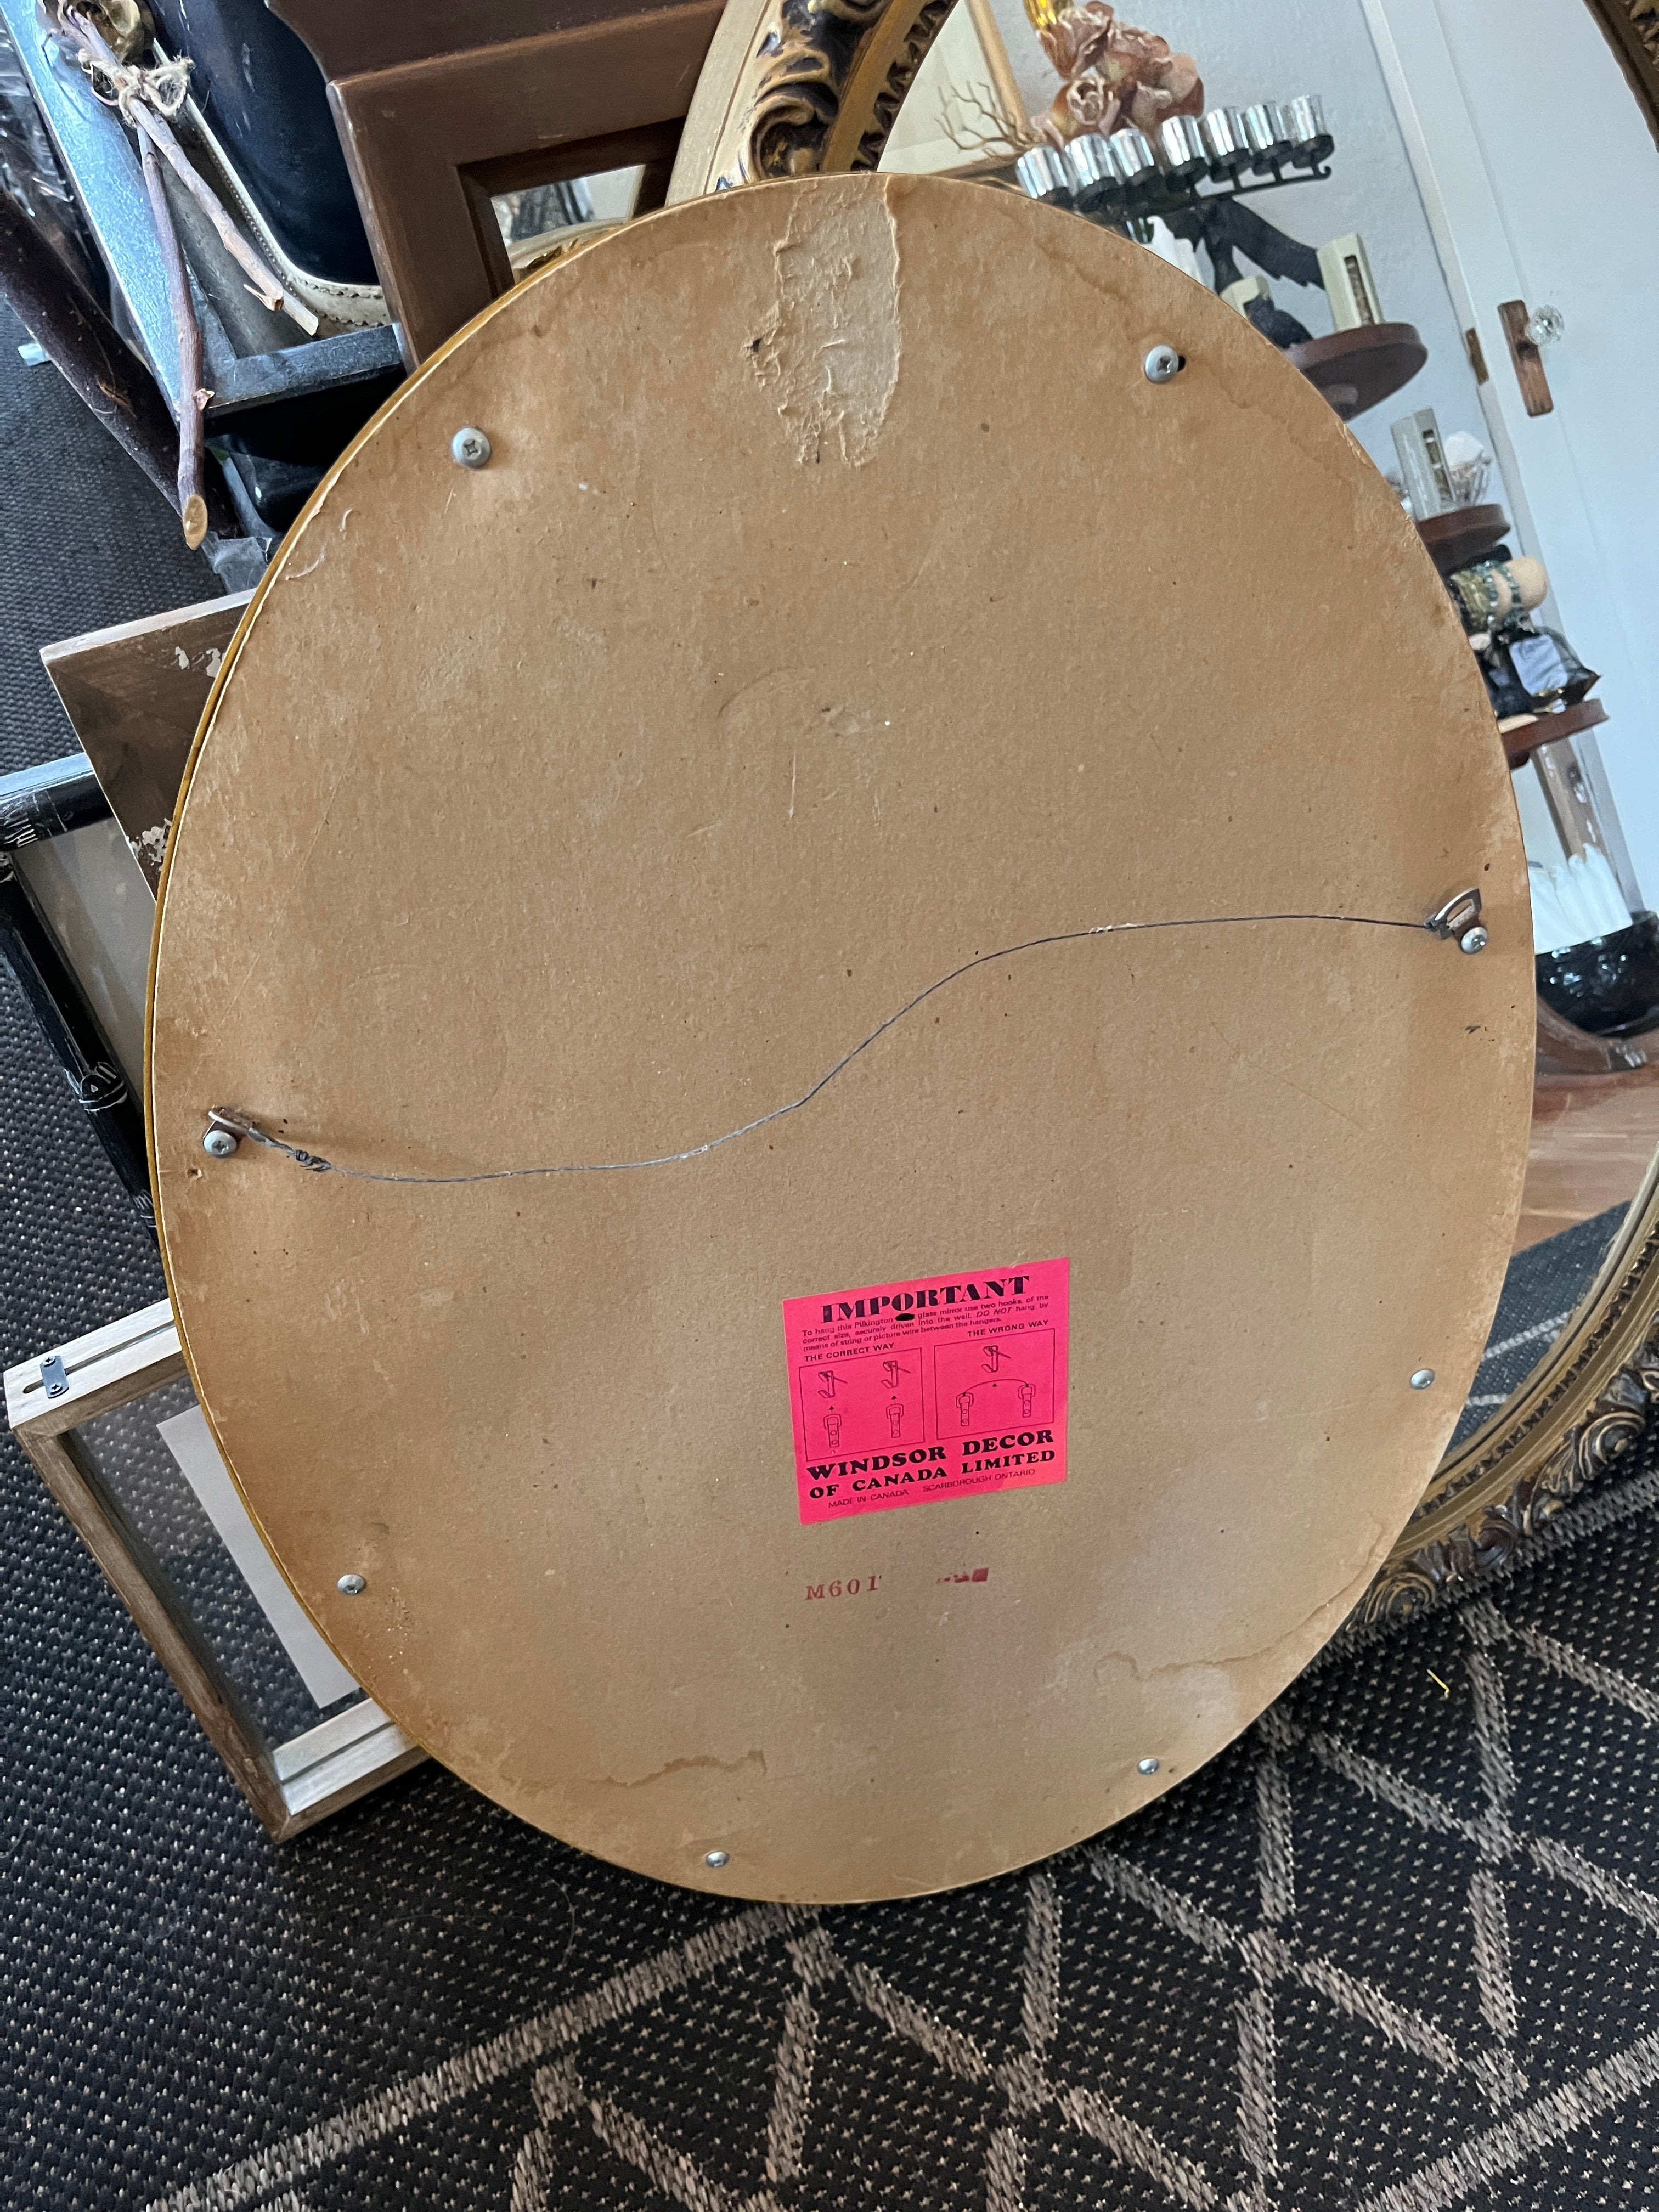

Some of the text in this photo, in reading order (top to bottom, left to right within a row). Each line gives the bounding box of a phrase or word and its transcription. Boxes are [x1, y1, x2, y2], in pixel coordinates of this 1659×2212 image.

[821, 1276, 1030, 1323] IMPORTANT
[803, 1334, 830, 1344] correct
[855, 1325, 886, 1335] securely
[890, 1321, 914, 1330] driven
[993, 1307, 1012, 1315] NOT
[855, 1317, 893, 1329] Pilkington
[918, 1311, 937, 1319] glass
[940, 1306, 962, 1316] mirror
[968, 1319, 1048, 1337] THE WRONG WAY
[803, 1342, 828, 1352] means
[840, 1335, 862, 1345] string
[873, 1331, 901, 1340] picture
[921, 1323, 953, 1333] between
[826, 1346, 870, 1358] CORRECT
[873, 1342, 895, 1352] WAY
[806, 1429, 1054, 1480] WINDSOR DECOR
[809, 1449, 1056, 1499] OF CANADA LIMITED
[923, 1468, 1036, 1492] SCARBOROUGH ONTARIO
[828, 1489, 910, 1508] MADE IN CANADA
[805, 1575, 879, 1600] M601
